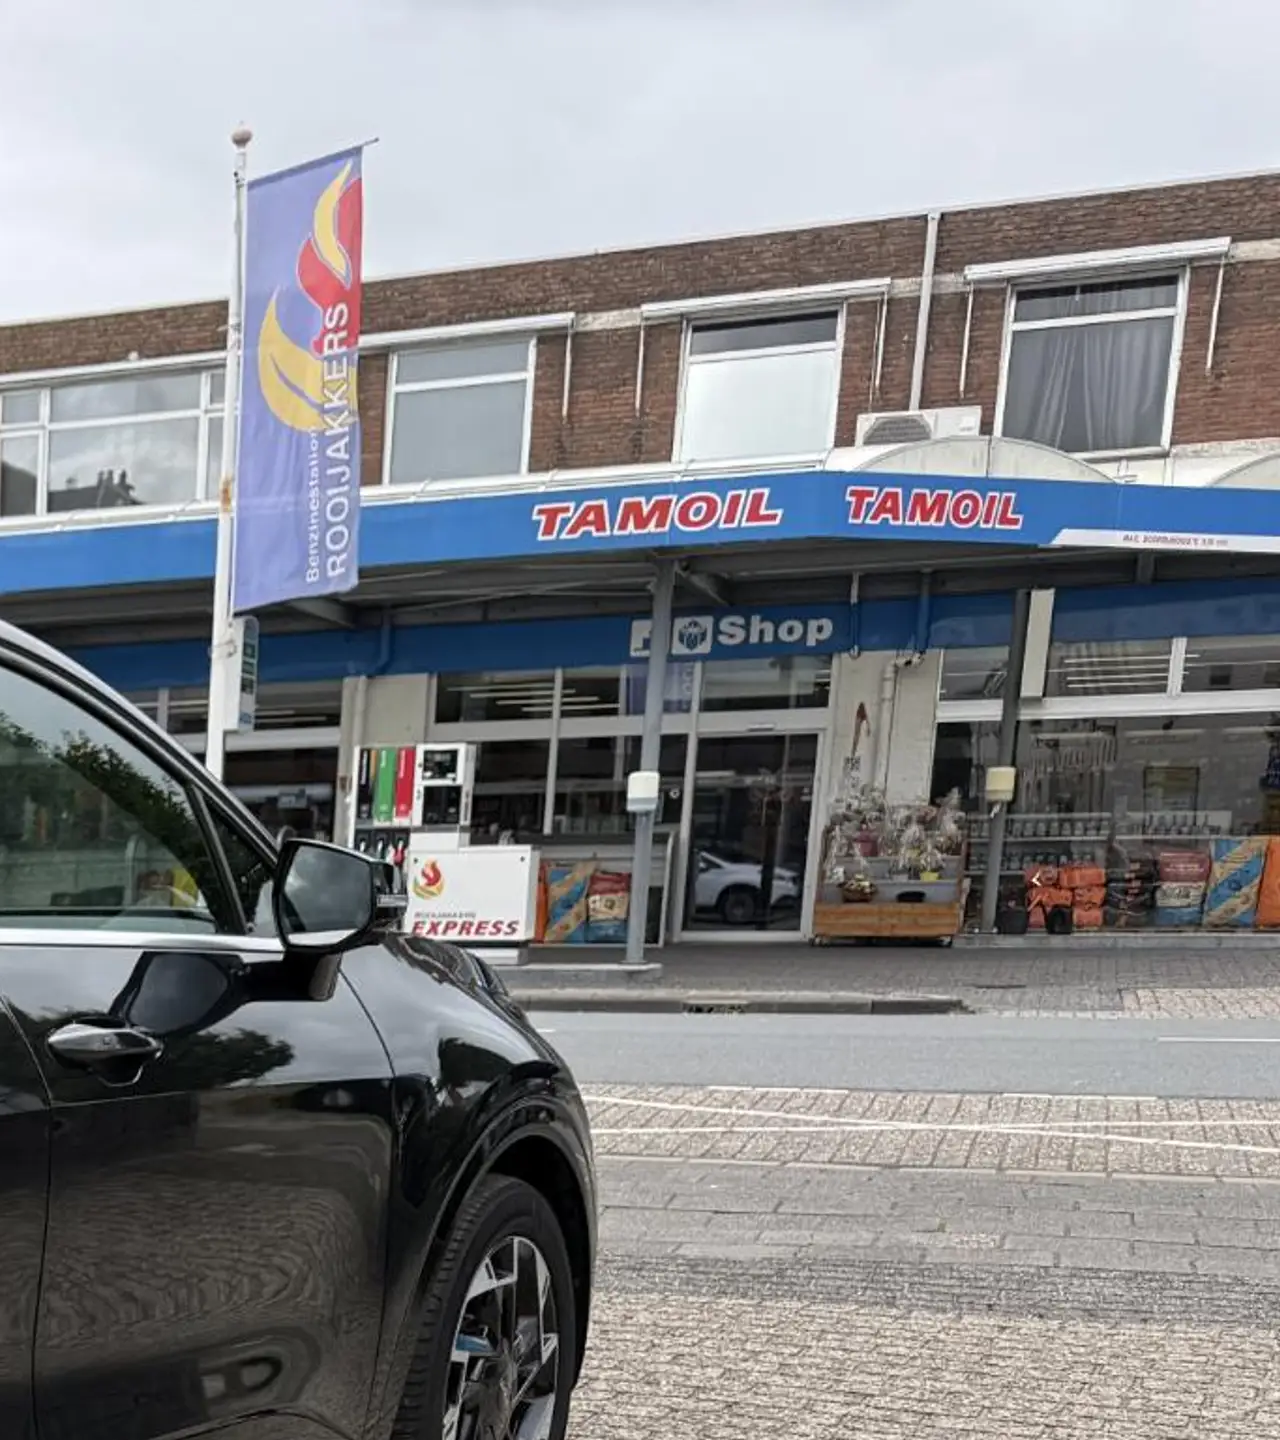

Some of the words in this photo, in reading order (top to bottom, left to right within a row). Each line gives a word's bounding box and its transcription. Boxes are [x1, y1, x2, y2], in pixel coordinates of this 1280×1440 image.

[323, 302, 351, 579] ROOIJAKKERS
[532, 486, 783, 541] TAMOIL
[845, 484, 1024, 530] TAMOIL
[717, 615, 833, 647] Shop
[412, 920, 520, 936] EXPRESS
